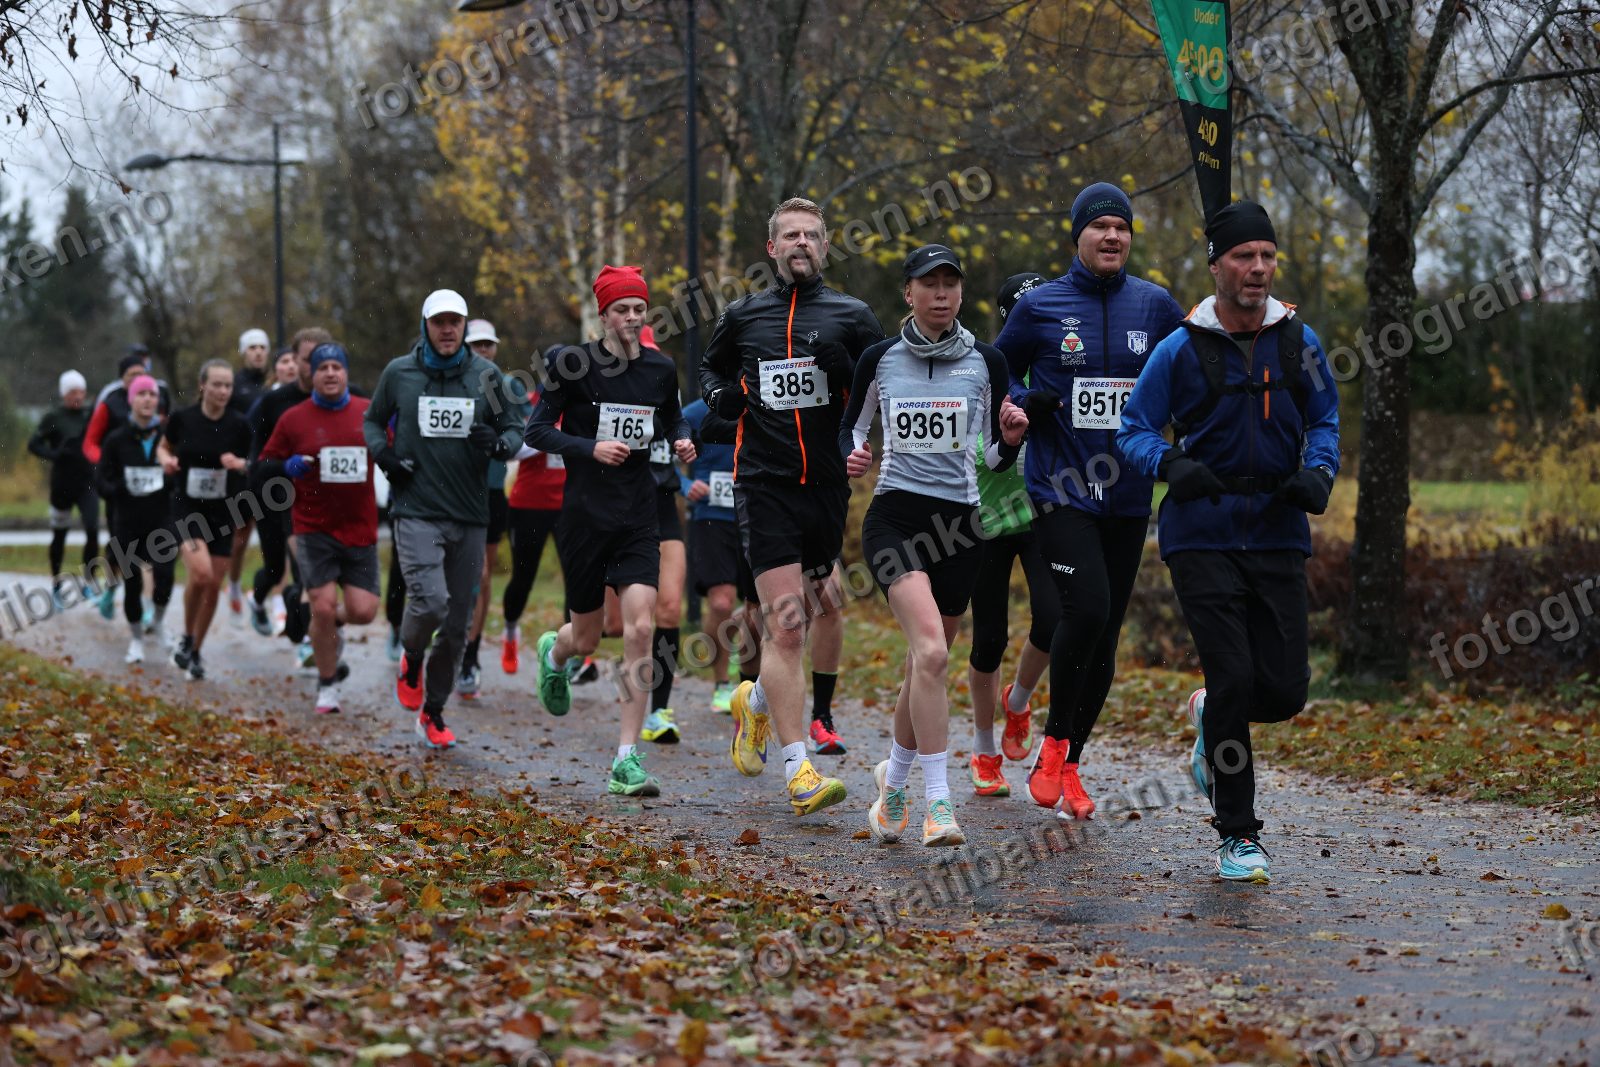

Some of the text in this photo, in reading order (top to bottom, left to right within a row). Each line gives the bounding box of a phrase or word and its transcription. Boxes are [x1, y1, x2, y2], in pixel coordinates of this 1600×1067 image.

[1194, 7, 1220, 25] Under
[772, 372, 815, 398] 385
[606, 406, 651, 415] NORGESTESTEN
[896, 401, 962, 409] NORGESTESTEN
[429, 410, 462, 428] 562
[896, 412, 957, 439] 9361
[612, 417, 643, 440] 165
[330, 457, 357, 474] 824
[1088, 483, 1103, 500] TN
